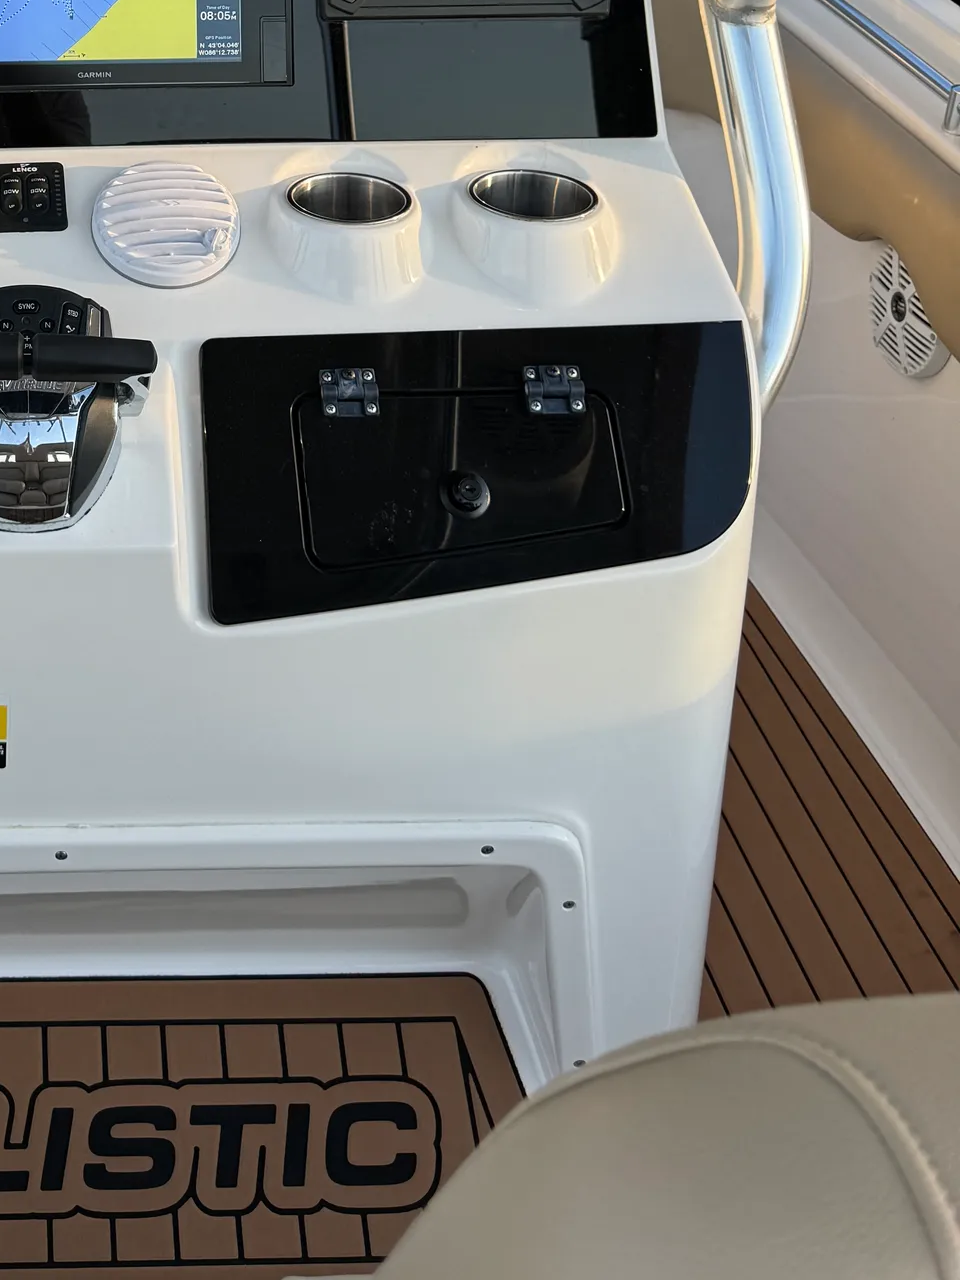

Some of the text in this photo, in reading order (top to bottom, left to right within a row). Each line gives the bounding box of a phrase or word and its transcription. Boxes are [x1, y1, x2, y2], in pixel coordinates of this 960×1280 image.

[200, 10, 231, 21] 08:05
[77, 71, 112, 79] GARMIN
[67, 309, 79, 318] STBD
